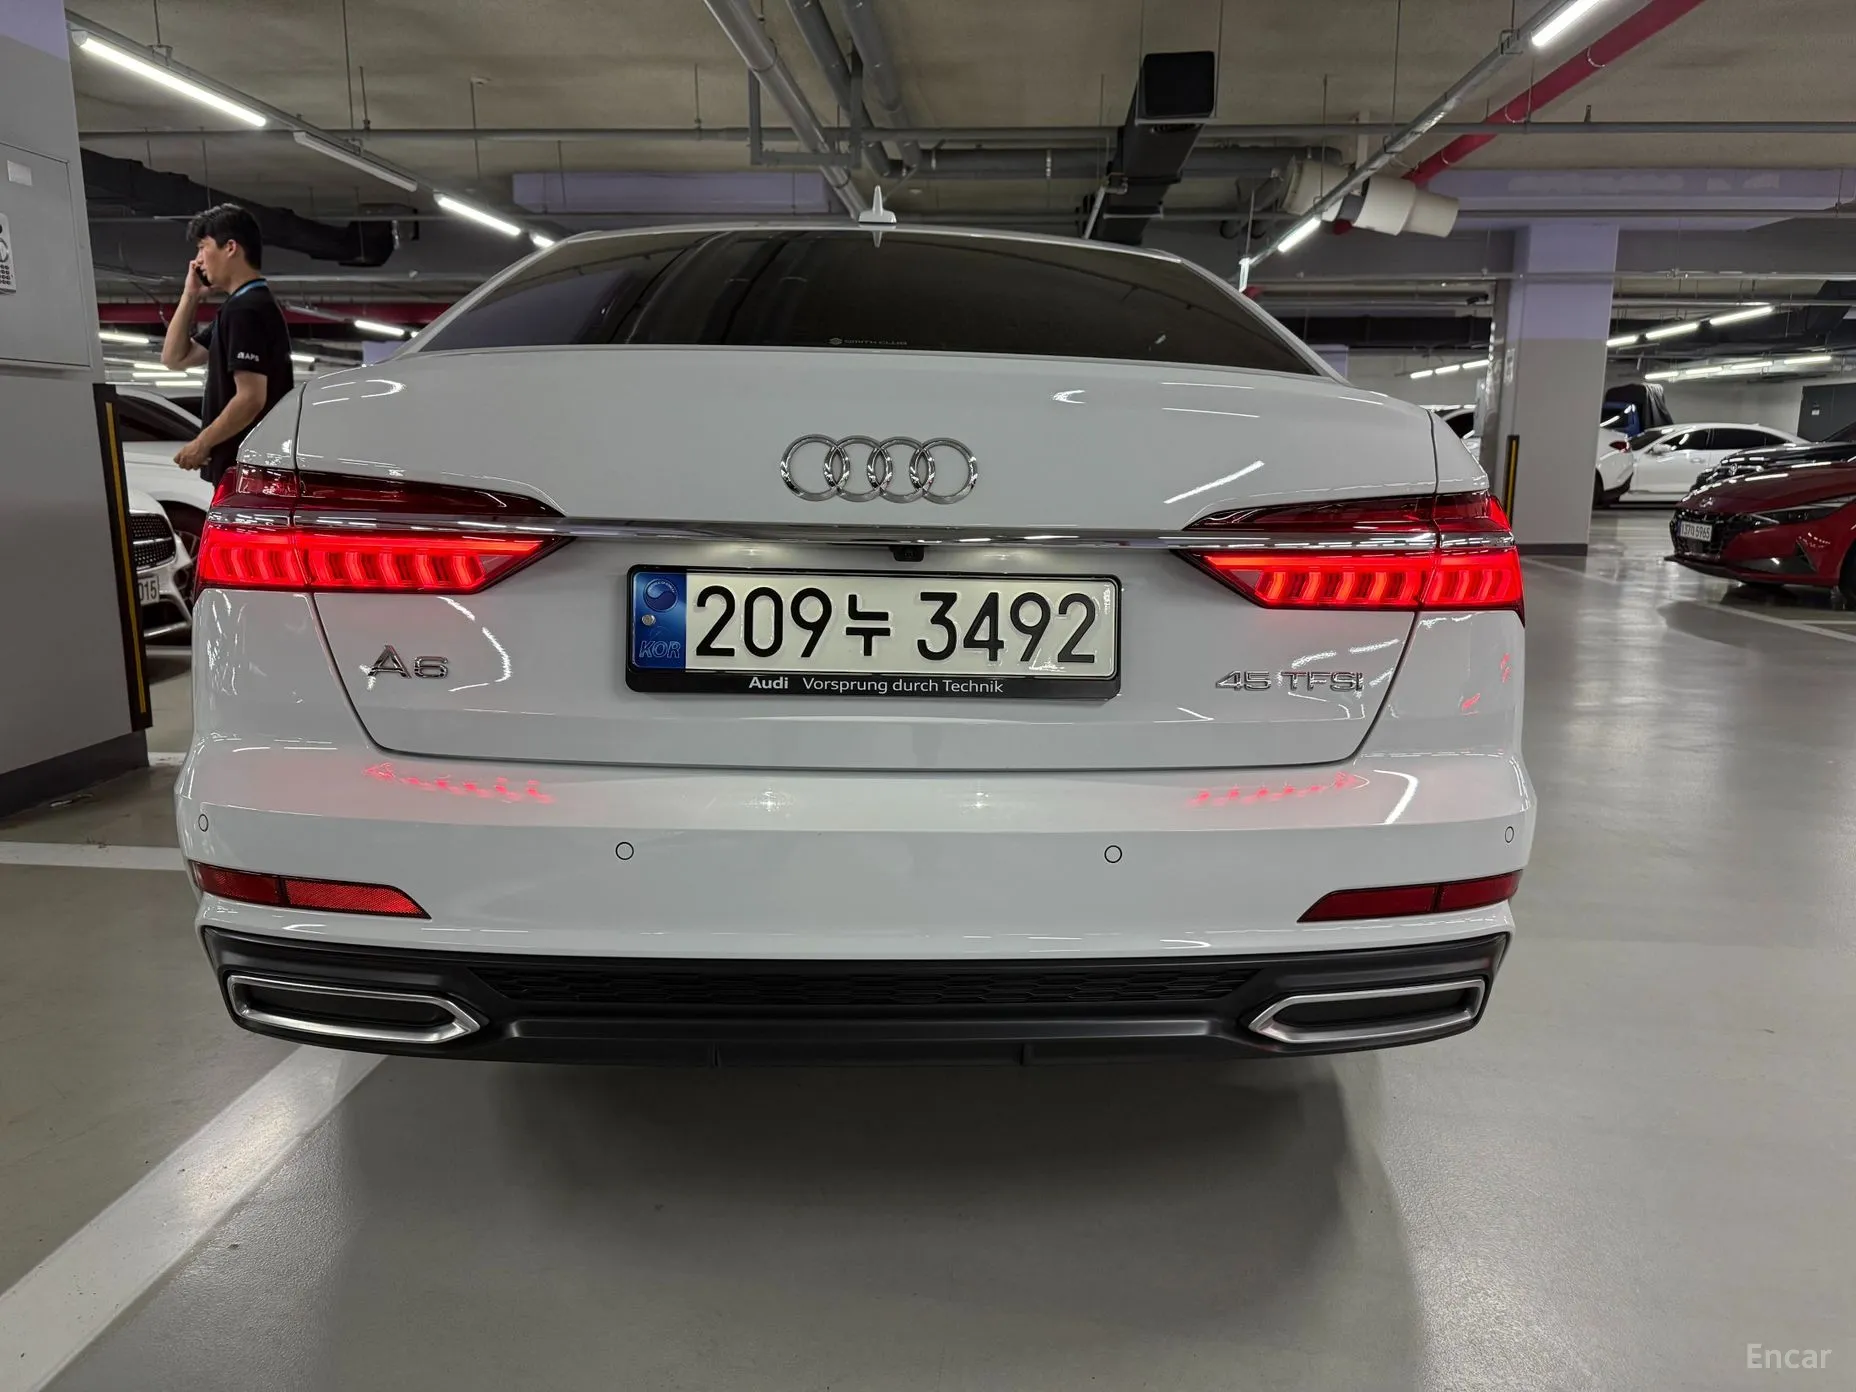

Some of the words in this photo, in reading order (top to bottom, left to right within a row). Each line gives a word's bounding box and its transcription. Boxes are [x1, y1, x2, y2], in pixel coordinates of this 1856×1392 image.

[695, 585, 891, 658] 209누
[916, 591, 1097, 664] 3492
[638, 639, 682, 659] KOR
[367, 644, 449, 679] A6
[748, 676, 789, 690] Audi
[802, 677, 888, 694] Vorsprung
[892, 679, 939, 693] durch
[942, 680, 1004, 693] Technik
[1215, 670, 1272, 692] 45
[1281, 671, 1365, 692] TFSI
